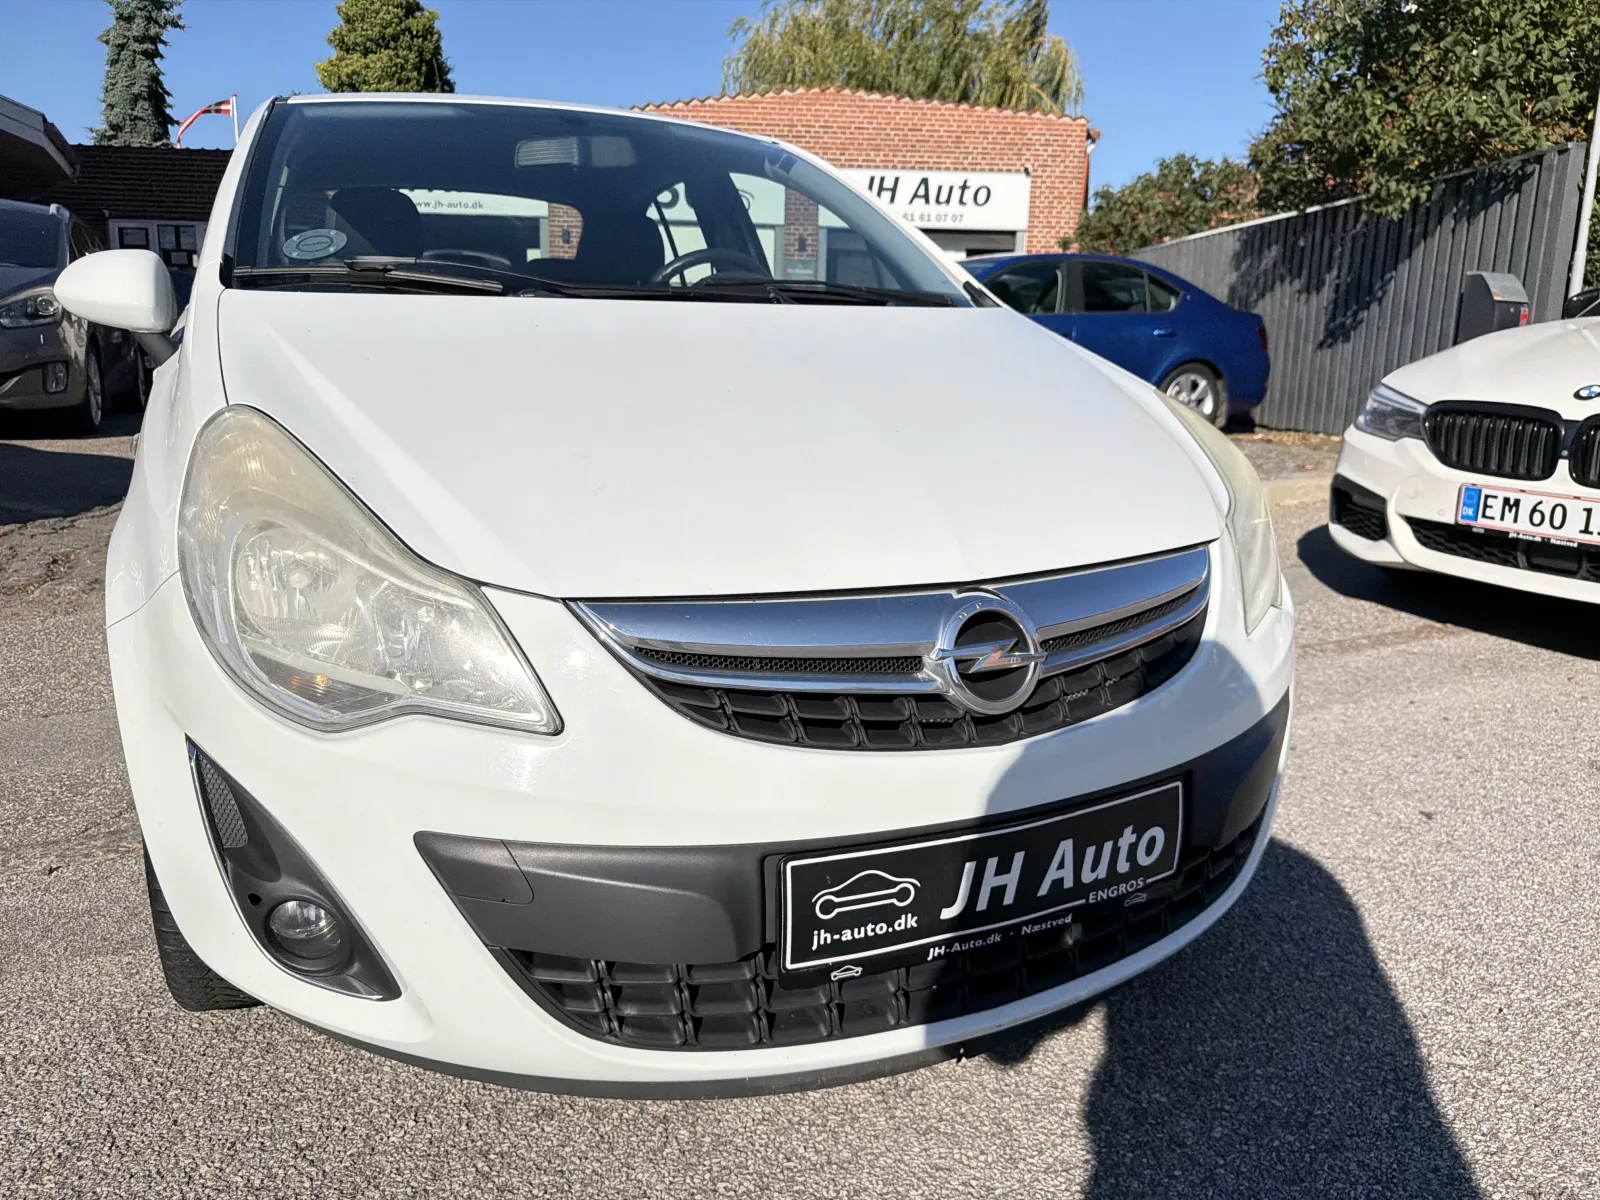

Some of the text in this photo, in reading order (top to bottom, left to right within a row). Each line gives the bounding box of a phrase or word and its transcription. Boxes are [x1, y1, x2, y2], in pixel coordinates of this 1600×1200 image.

[908, 177, 991, 206] Auto
[1462, 506, 1474, 517] DK
[1481, 494, 1600, 536] EM 60 1
[940, 824, 1165, 920] JH Auto
[1088, 877, 1145, 904] ENGROS
[811, 913, 918, 951] jh-auto.dk
[927, 913, 1072, 961] JH-Auto.dk Næstved
